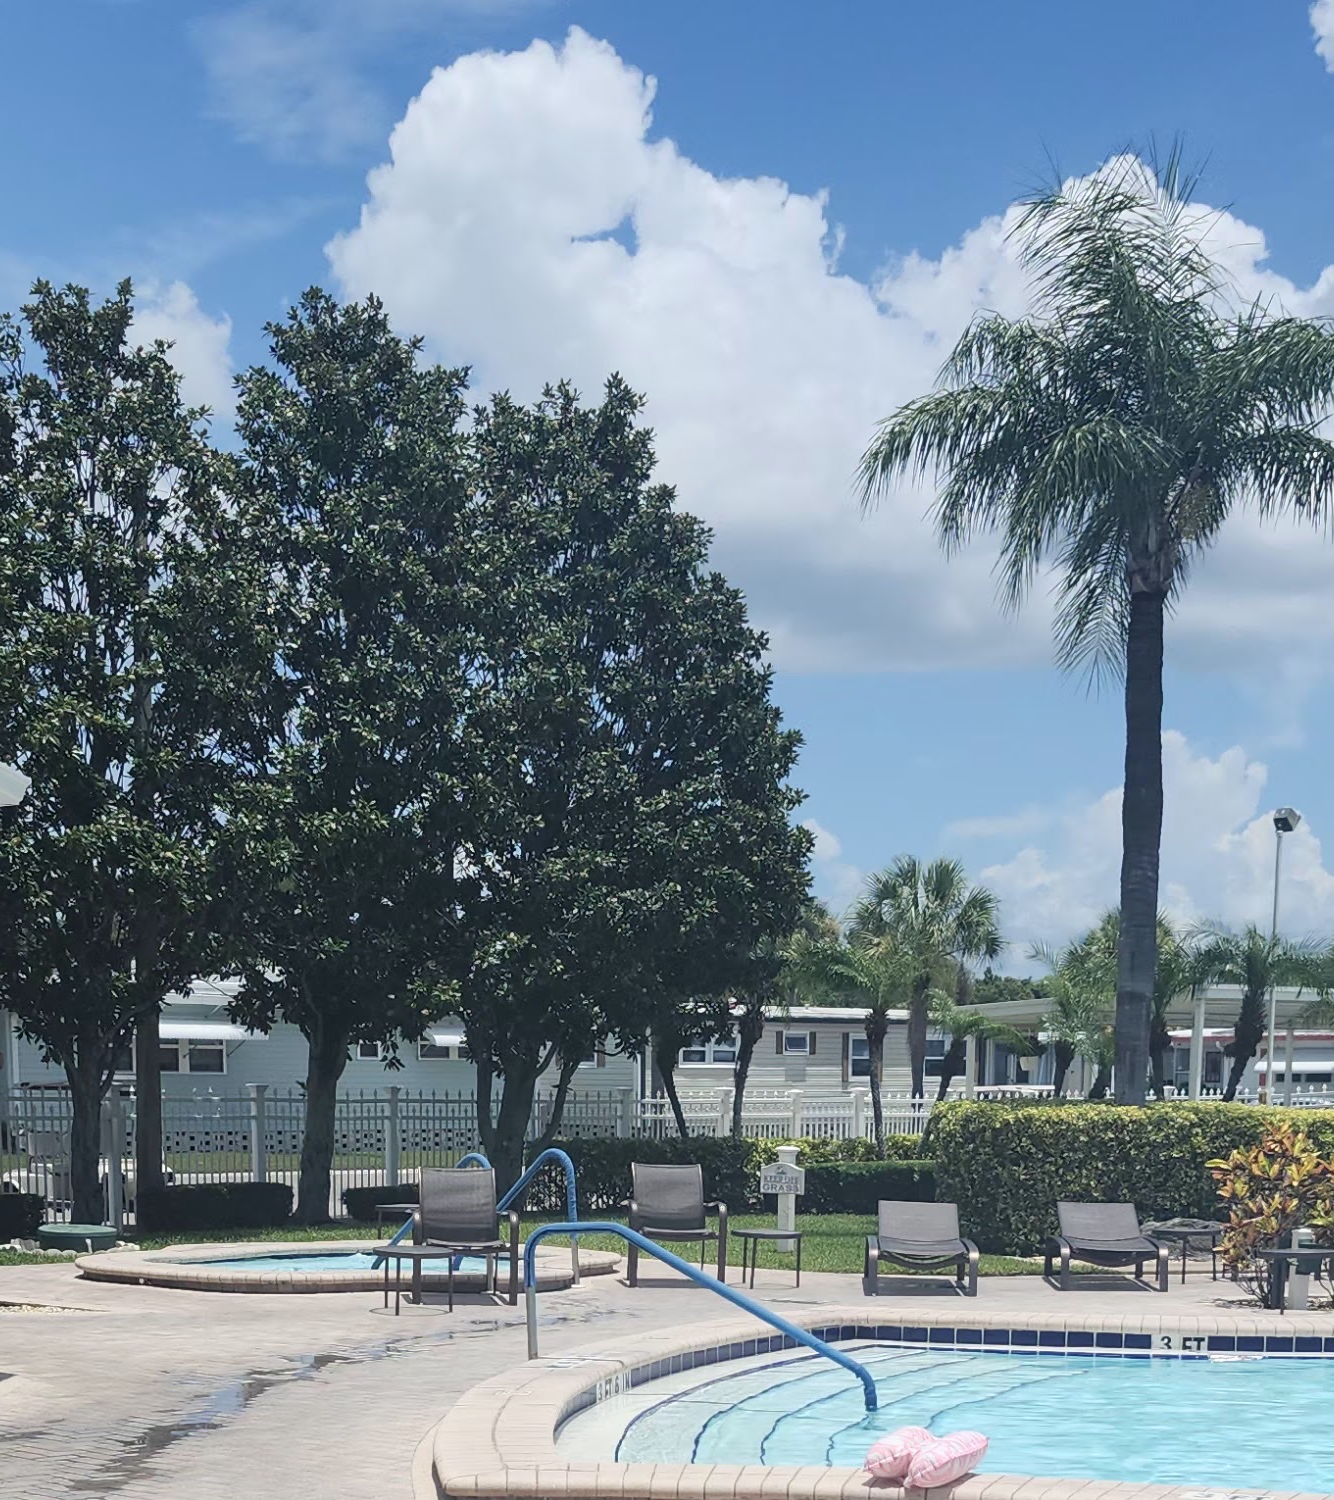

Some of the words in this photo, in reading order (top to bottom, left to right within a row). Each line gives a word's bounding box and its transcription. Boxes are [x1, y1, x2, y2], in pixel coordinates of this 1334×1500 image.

[762, 1184, 799, 1192] GRASS
[1160, 1336, 1172, 1349] 3
[1182, 1336, 1205, 1350] FT
[598, 1383, 603, 1401] 3
[605, 1378, 612, 1398] FT
[614, 1375, 620, 1394] 6
[622, 1371, 630, 1391] IN
